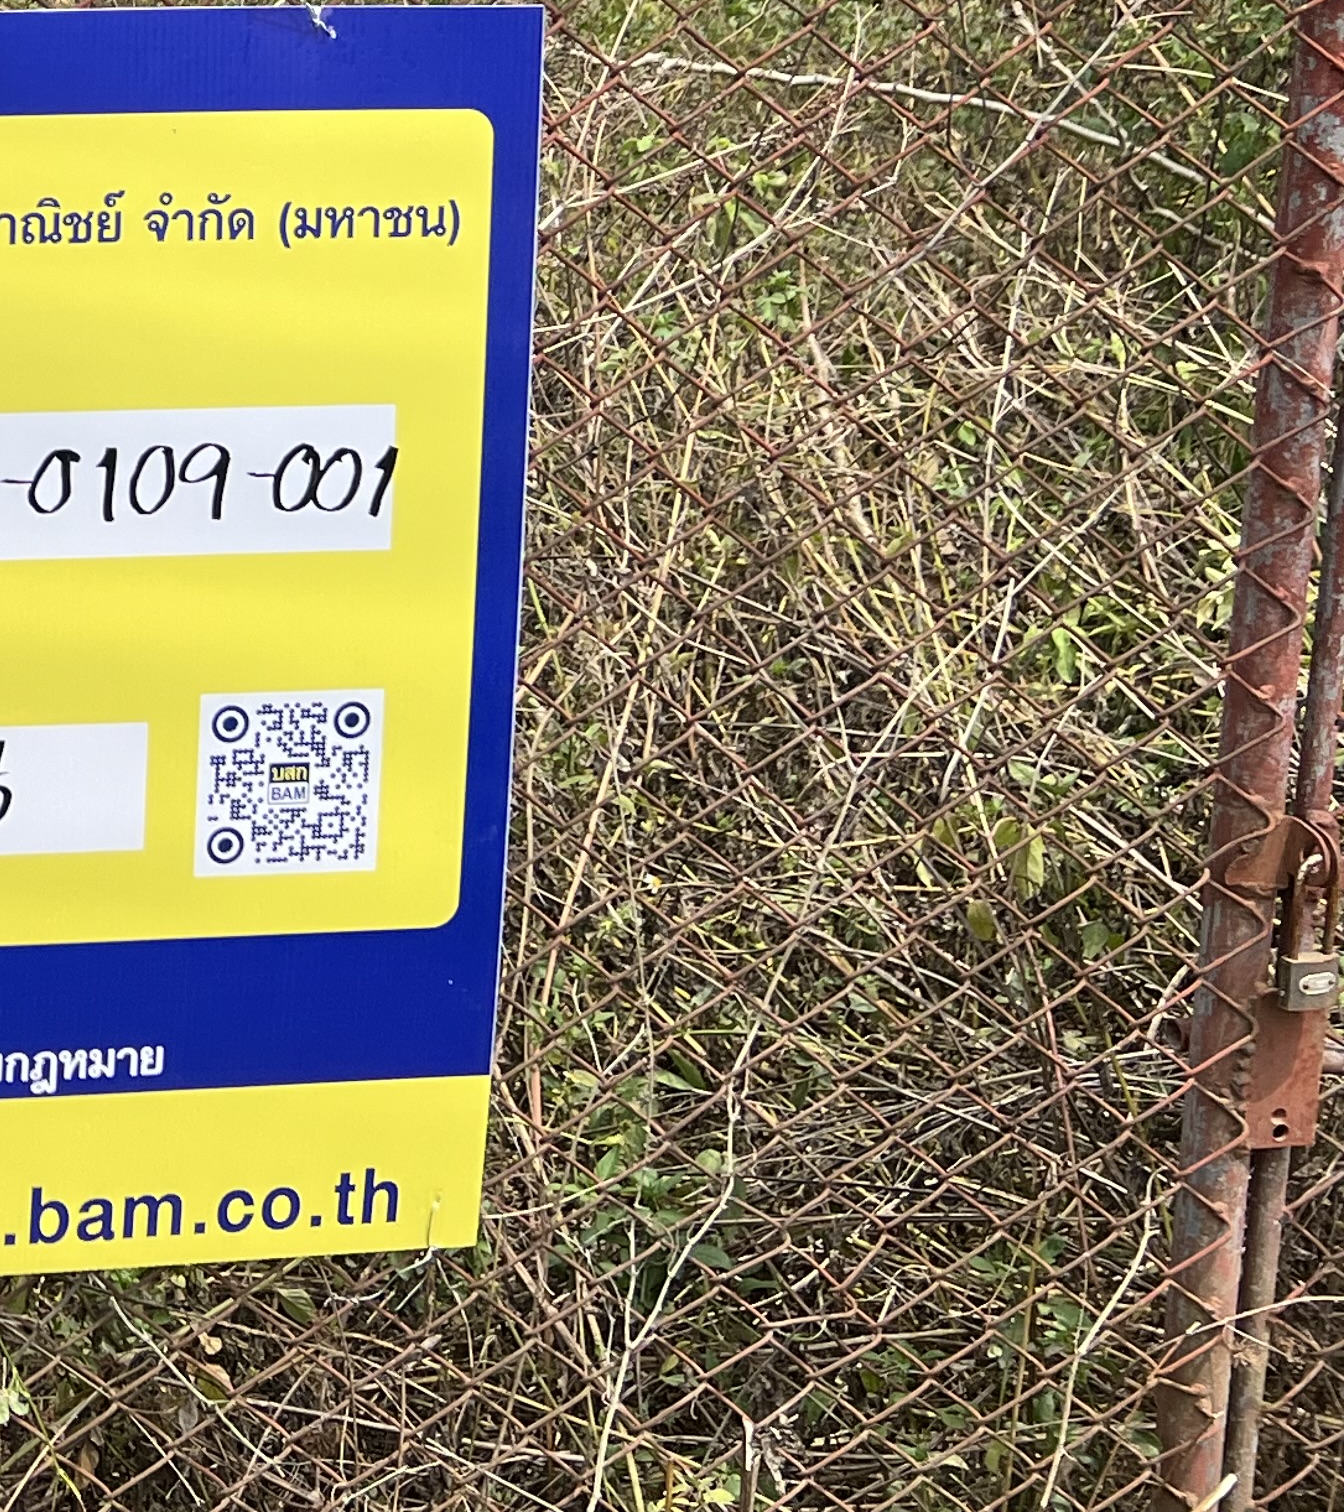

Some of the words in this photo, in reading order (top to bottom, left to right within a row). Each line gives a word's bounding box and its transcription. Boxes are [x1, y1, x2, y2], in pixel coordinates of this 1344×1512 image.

[142, 191, 255, 243] จำกัด
[278, 199, 461, 250] (มหาชน)
[270, 786, 306, 801] BAM
